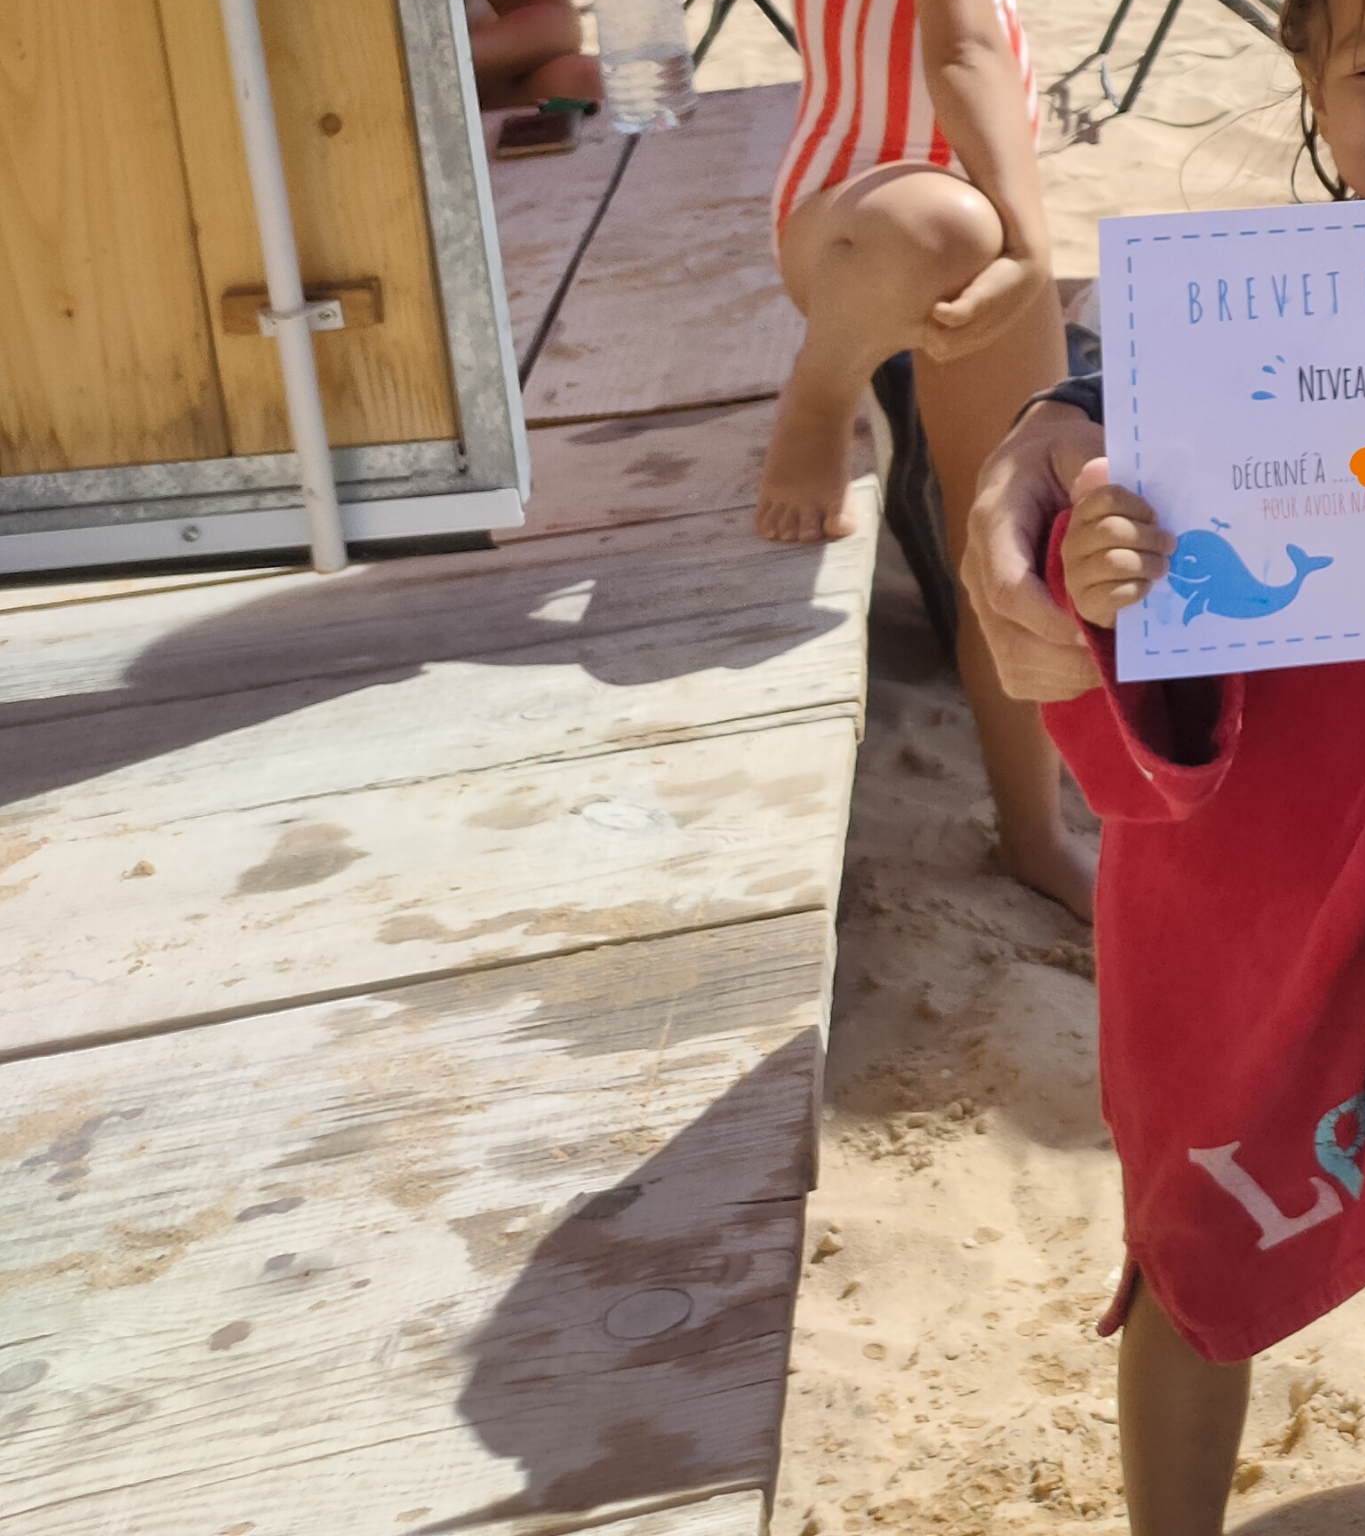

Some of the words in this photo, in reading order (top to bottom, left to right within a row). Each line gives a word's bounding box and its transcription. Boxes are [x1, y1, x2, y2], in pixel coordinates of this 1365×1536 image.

[1187, 270, 1341, 325] BREVET
[1231, 450, 1309, 491] DÉCERNÉ
[1313, 451, 1327, 485] À
[1262, 497, 1299, 520] POUR
[1304, 492, 1347, 516] AVOIR
